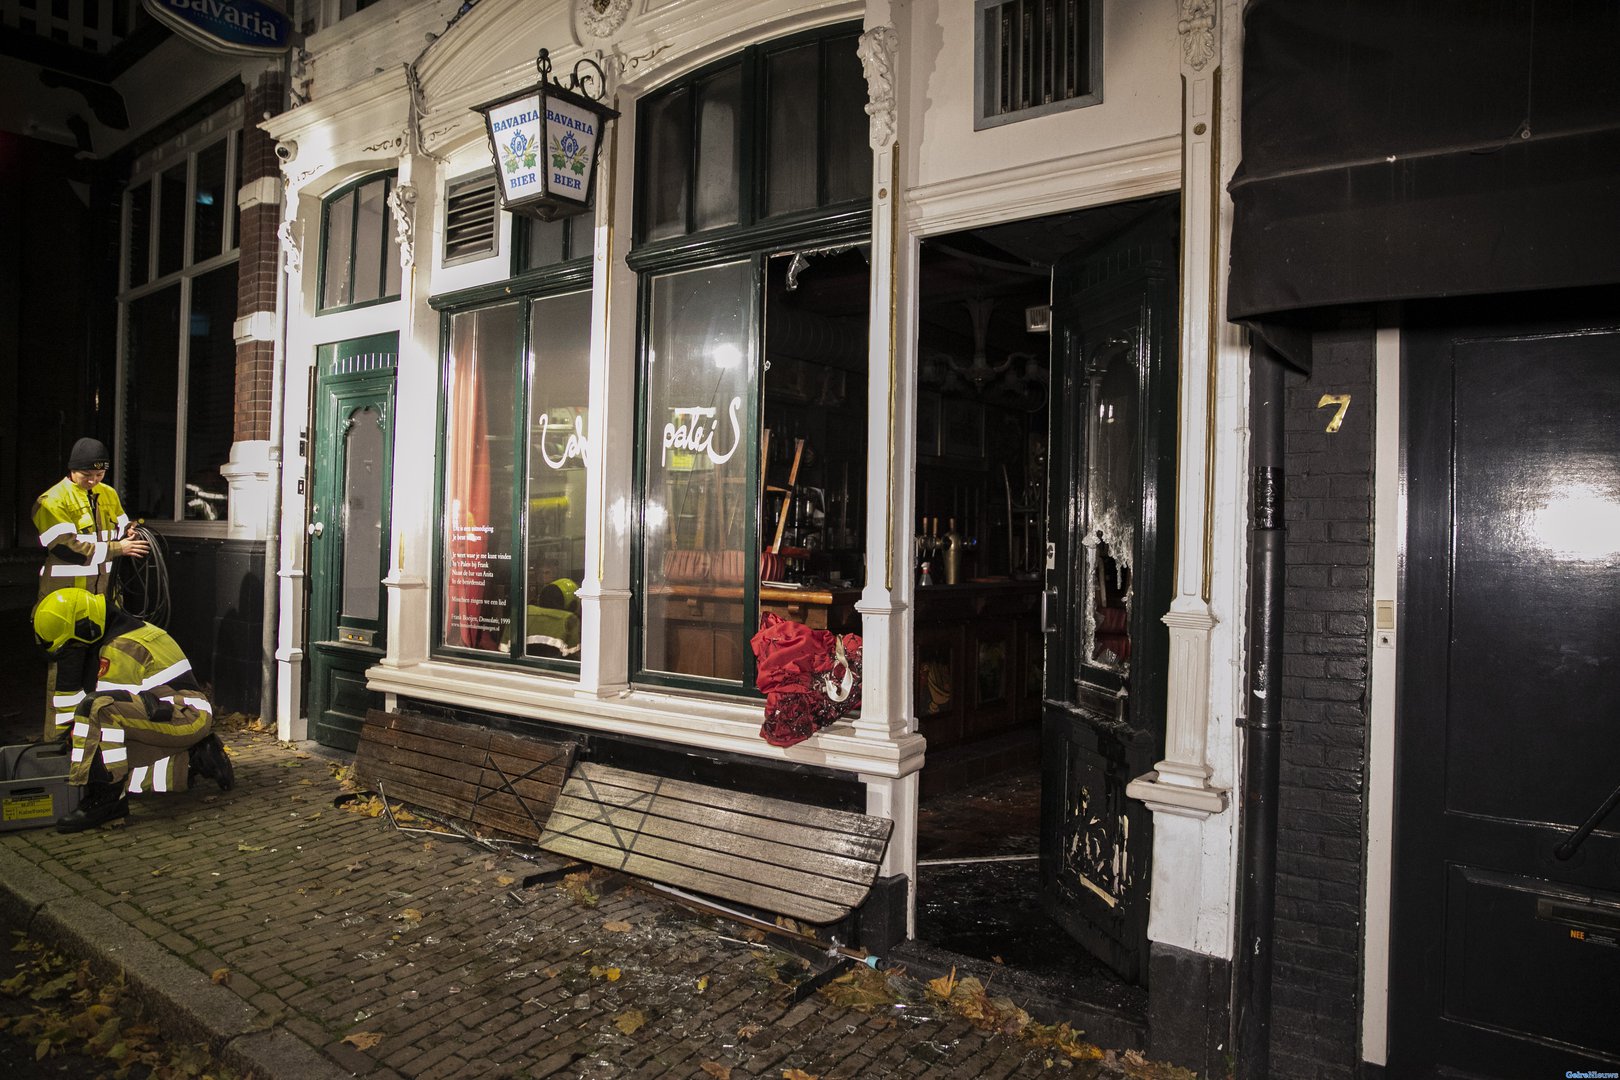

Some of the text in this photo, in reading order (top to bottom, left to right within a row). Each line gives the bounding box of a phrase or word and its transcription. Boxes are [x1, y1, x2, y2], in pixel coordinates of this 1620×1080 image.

[493, 110, 540, 133] BAVARIA
[546, 110, 594, 135] BAVARIA
[510, 173, 537, 188] BIER
[554, 173, 581, 190] BIER
[1318, 394, 1351, 432] 7
[1570, 929, 1585, 940] NEE
